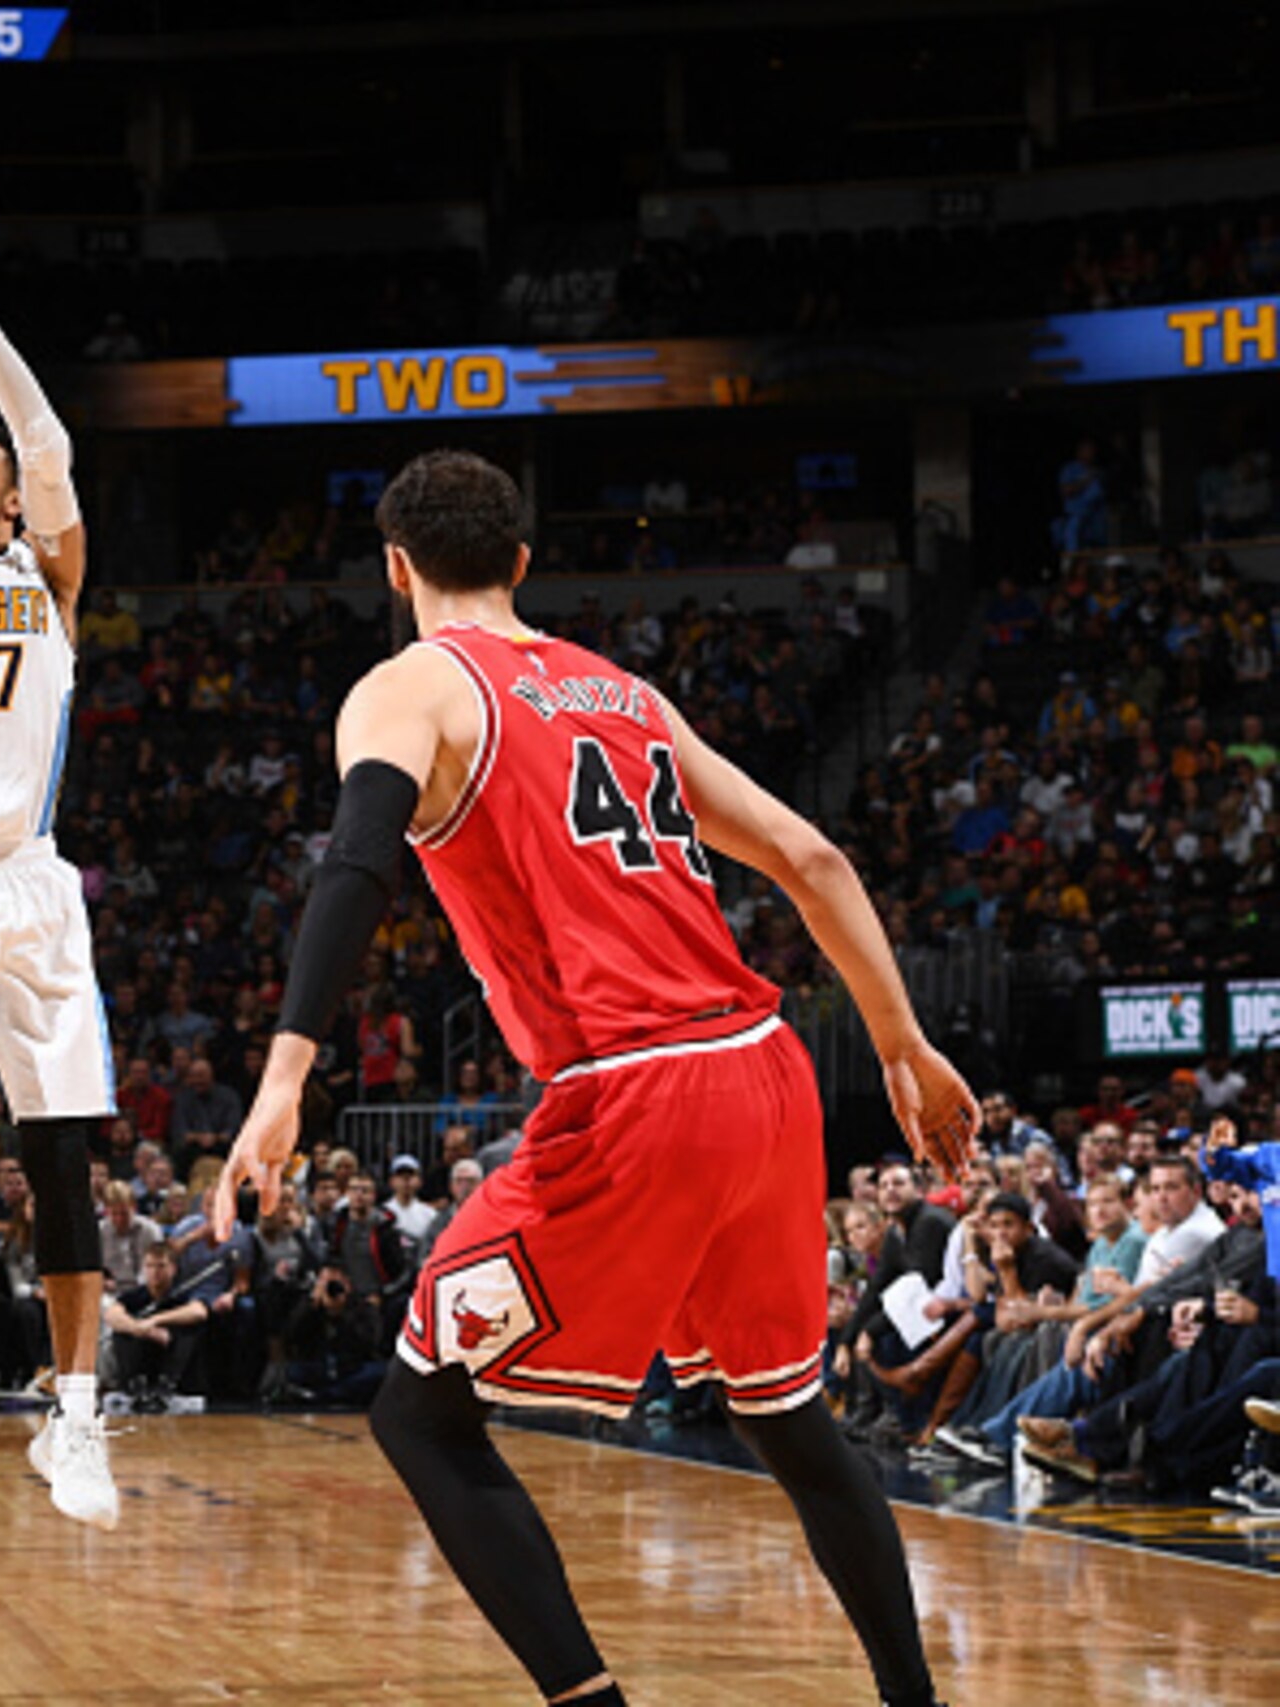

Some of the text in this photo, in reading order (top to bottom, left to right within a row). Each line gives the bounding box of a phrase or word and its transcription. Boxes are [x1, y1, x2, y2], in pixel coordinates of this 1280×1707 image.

[1168, 304, 1276, 368] TH
[322, 355, 505, 414] TWO
[563, 736, 715, 885] 44
